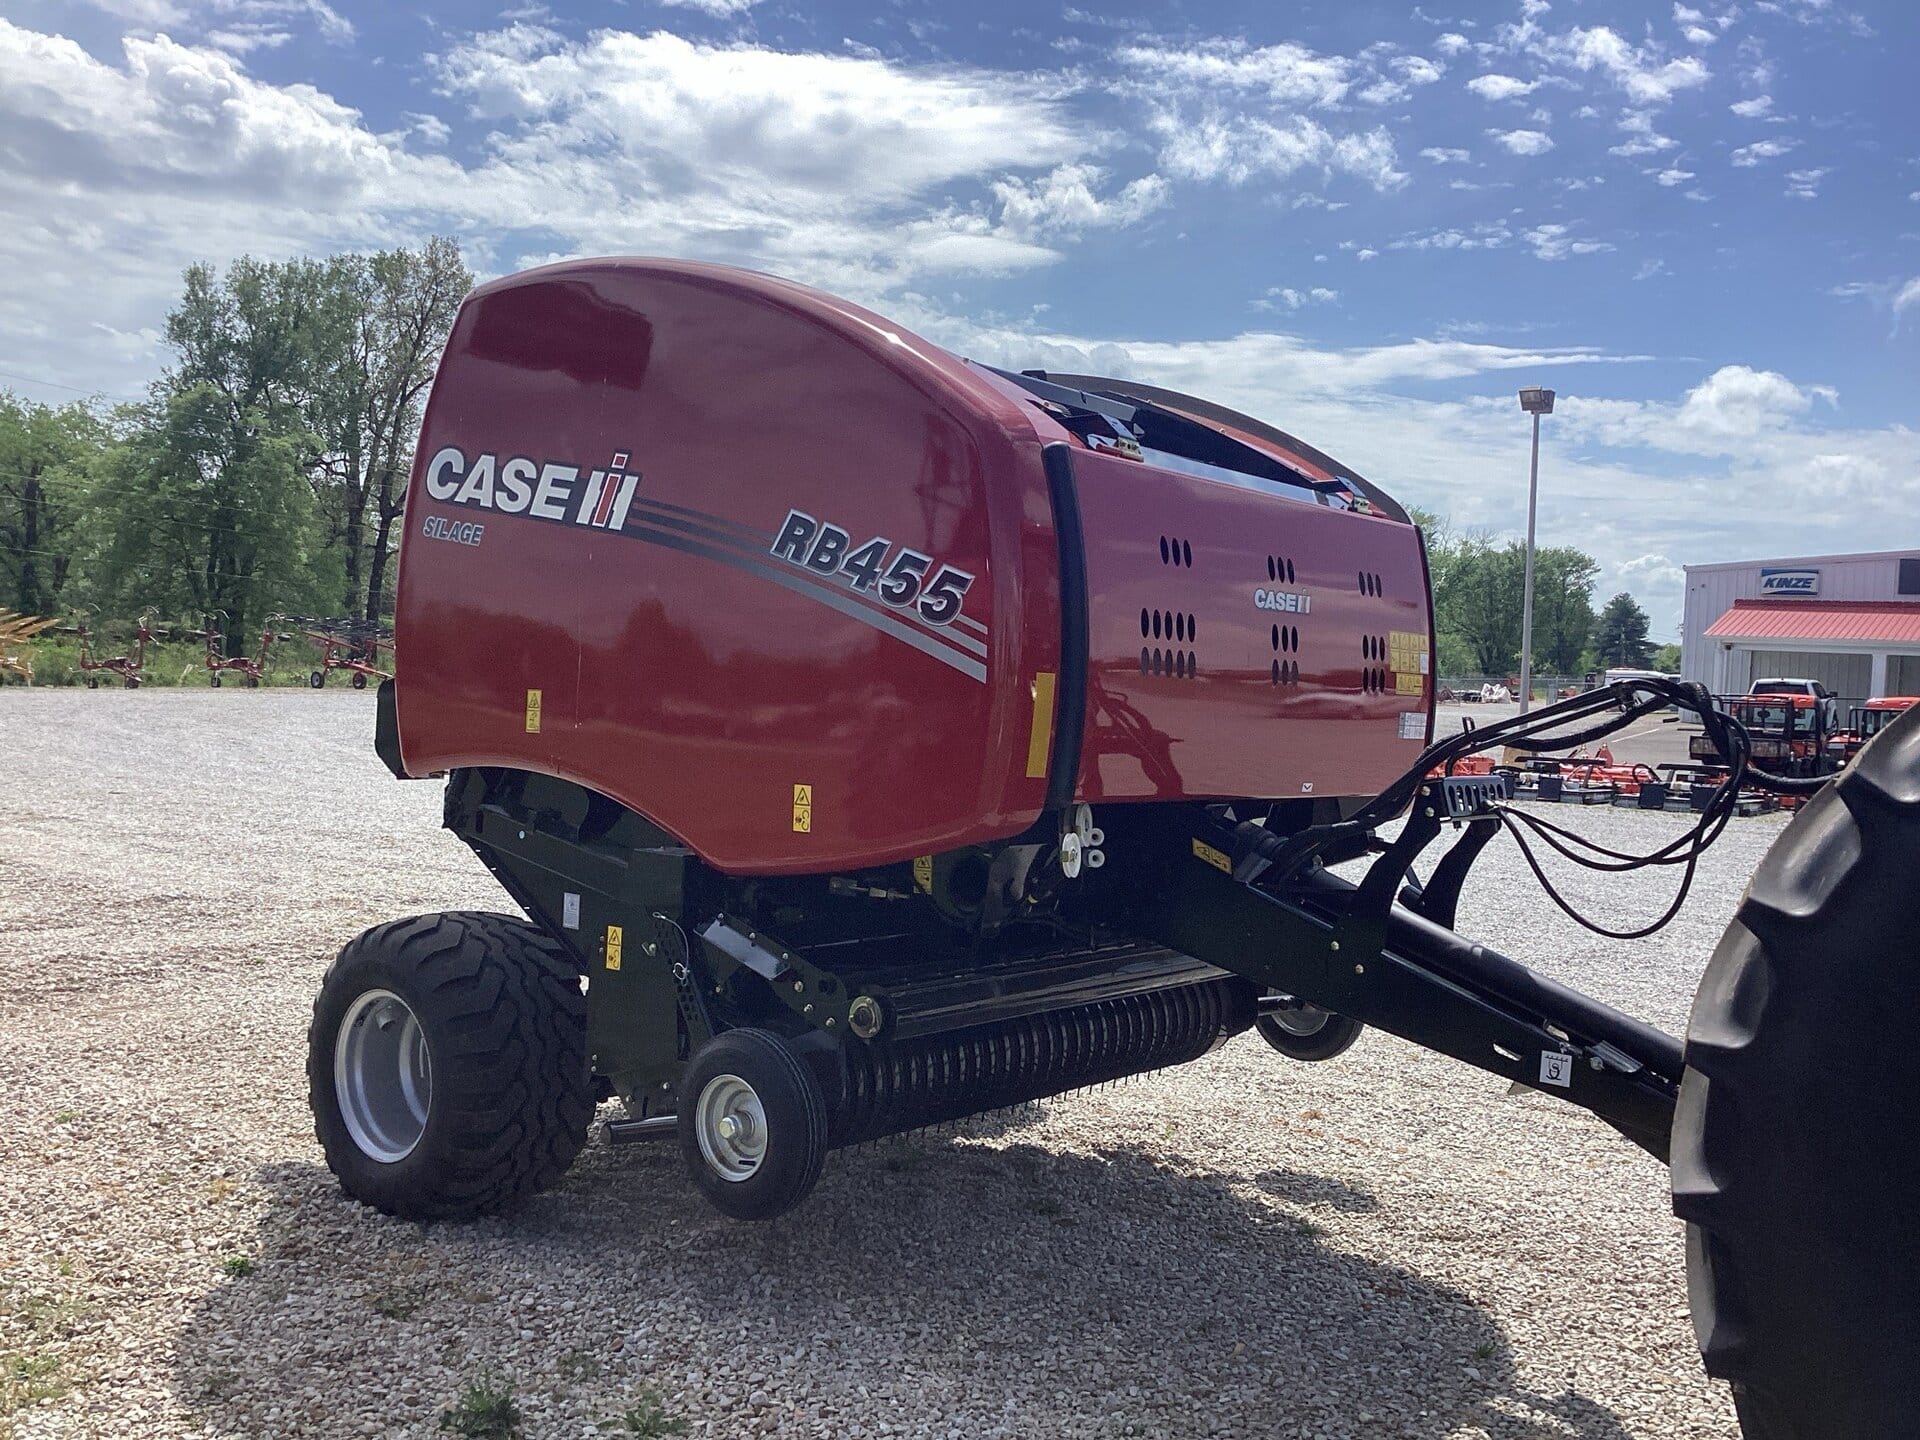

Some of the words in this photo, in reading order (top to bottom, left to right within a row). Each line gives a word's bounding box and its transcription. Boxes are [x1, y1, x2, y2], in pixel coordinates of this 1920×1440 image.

[426, 447, 579, 520] CASE
[422, 515, 485, 547] SILAGE
[770, 508, 976, 627] RB455
[1763, 577, 1815, 589] KINZE
[1254, 588, 1297, 612] CASE
